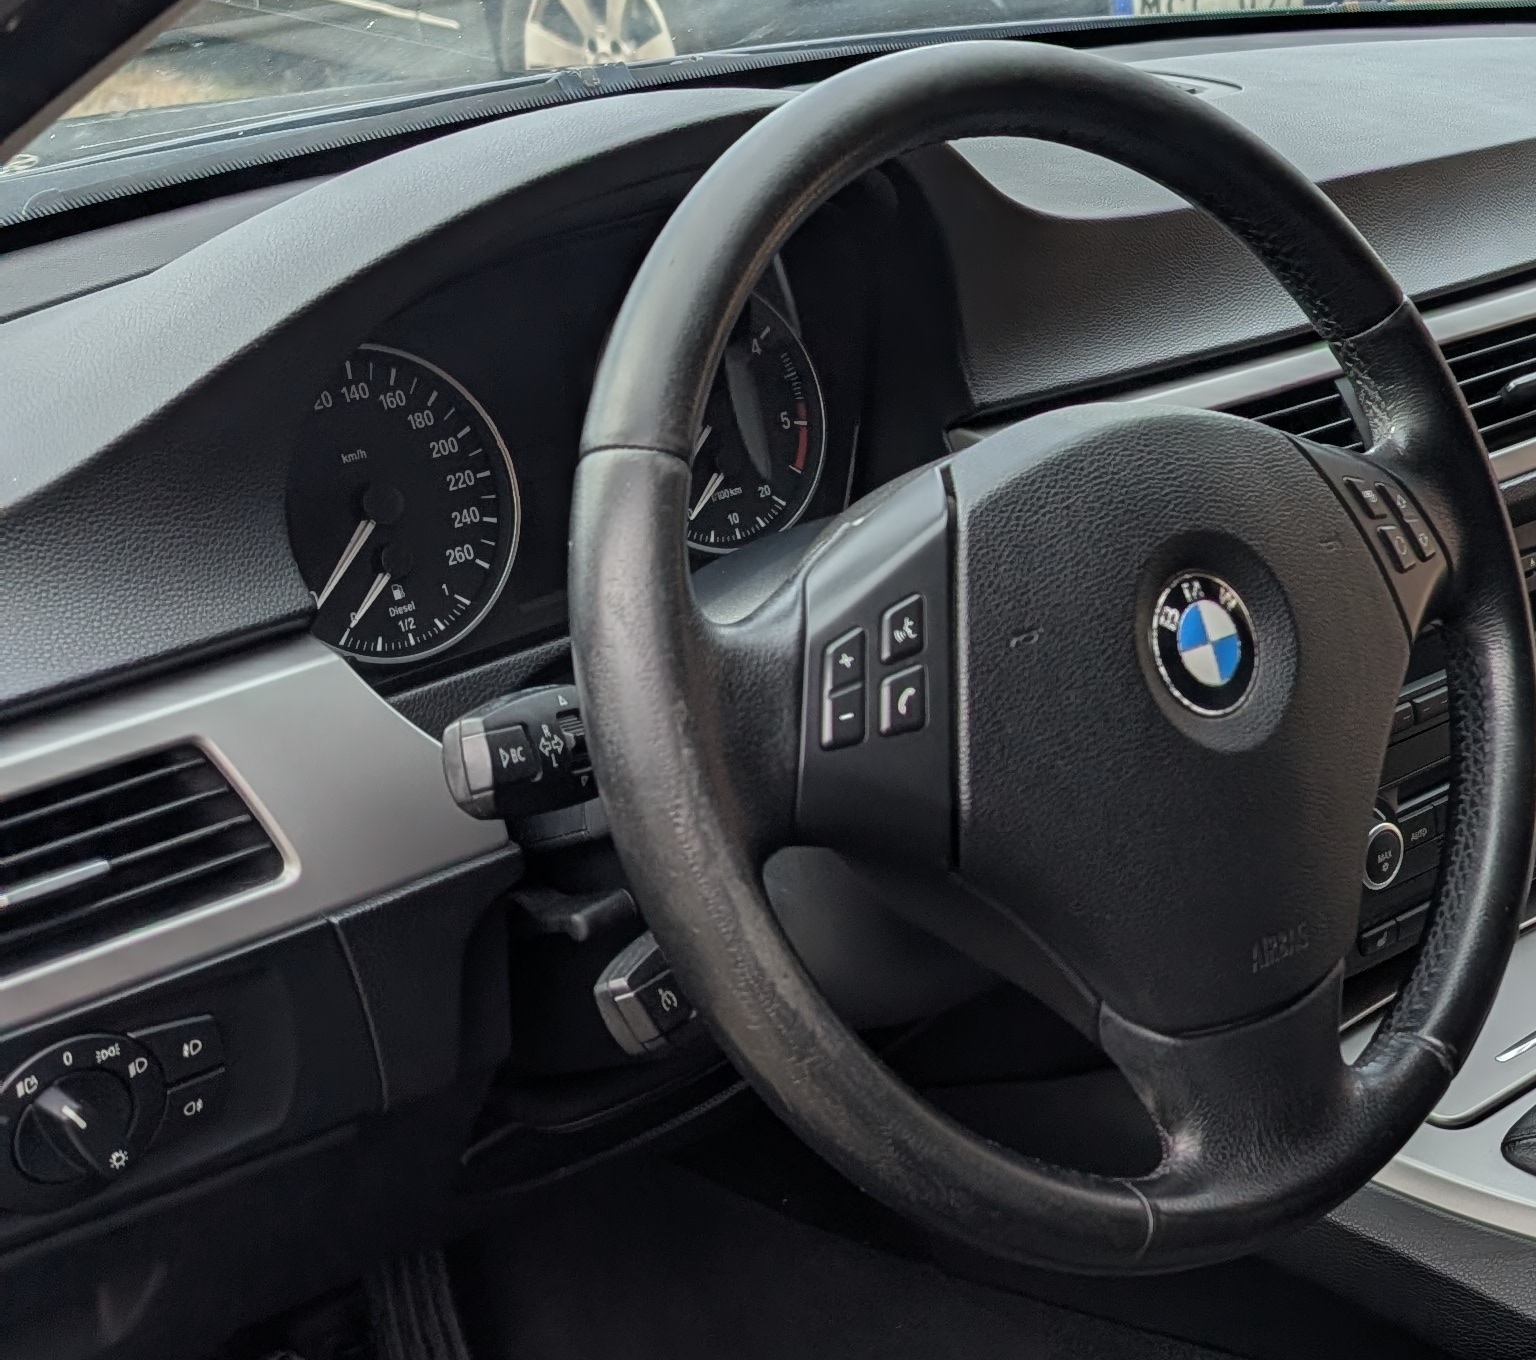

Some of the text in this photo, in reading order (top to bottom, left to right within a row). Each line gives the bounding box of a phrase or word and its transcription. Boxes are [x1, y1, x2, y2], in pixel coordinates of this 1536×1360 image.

[751, 339, 762, 356] 4
[341, 382, 370, 403] 140
[378, 390, 406, 410] 160
[407, 409, 435, 430] 180
[780, 411, 791, 429] 5
[340, 448, 368, 464] km/h
[429, 436, 459, 458] 200
[446, 469, 475, 491] 220
[757, 484, 771, 498] 20
[451, 506, 480, 528] 240
[727, 512, 740, 526] 10
[445, 543, 475, 566] 260
[441, 583, 450, 596] 1
[388, 600, 416, 617] Diesel
[1157, 578, 1239, 633] BMW
[398, 617, 417, 632] 1/2
[509, 746, 526, 764] BC
[62, 1051, 73, 1066] 0
